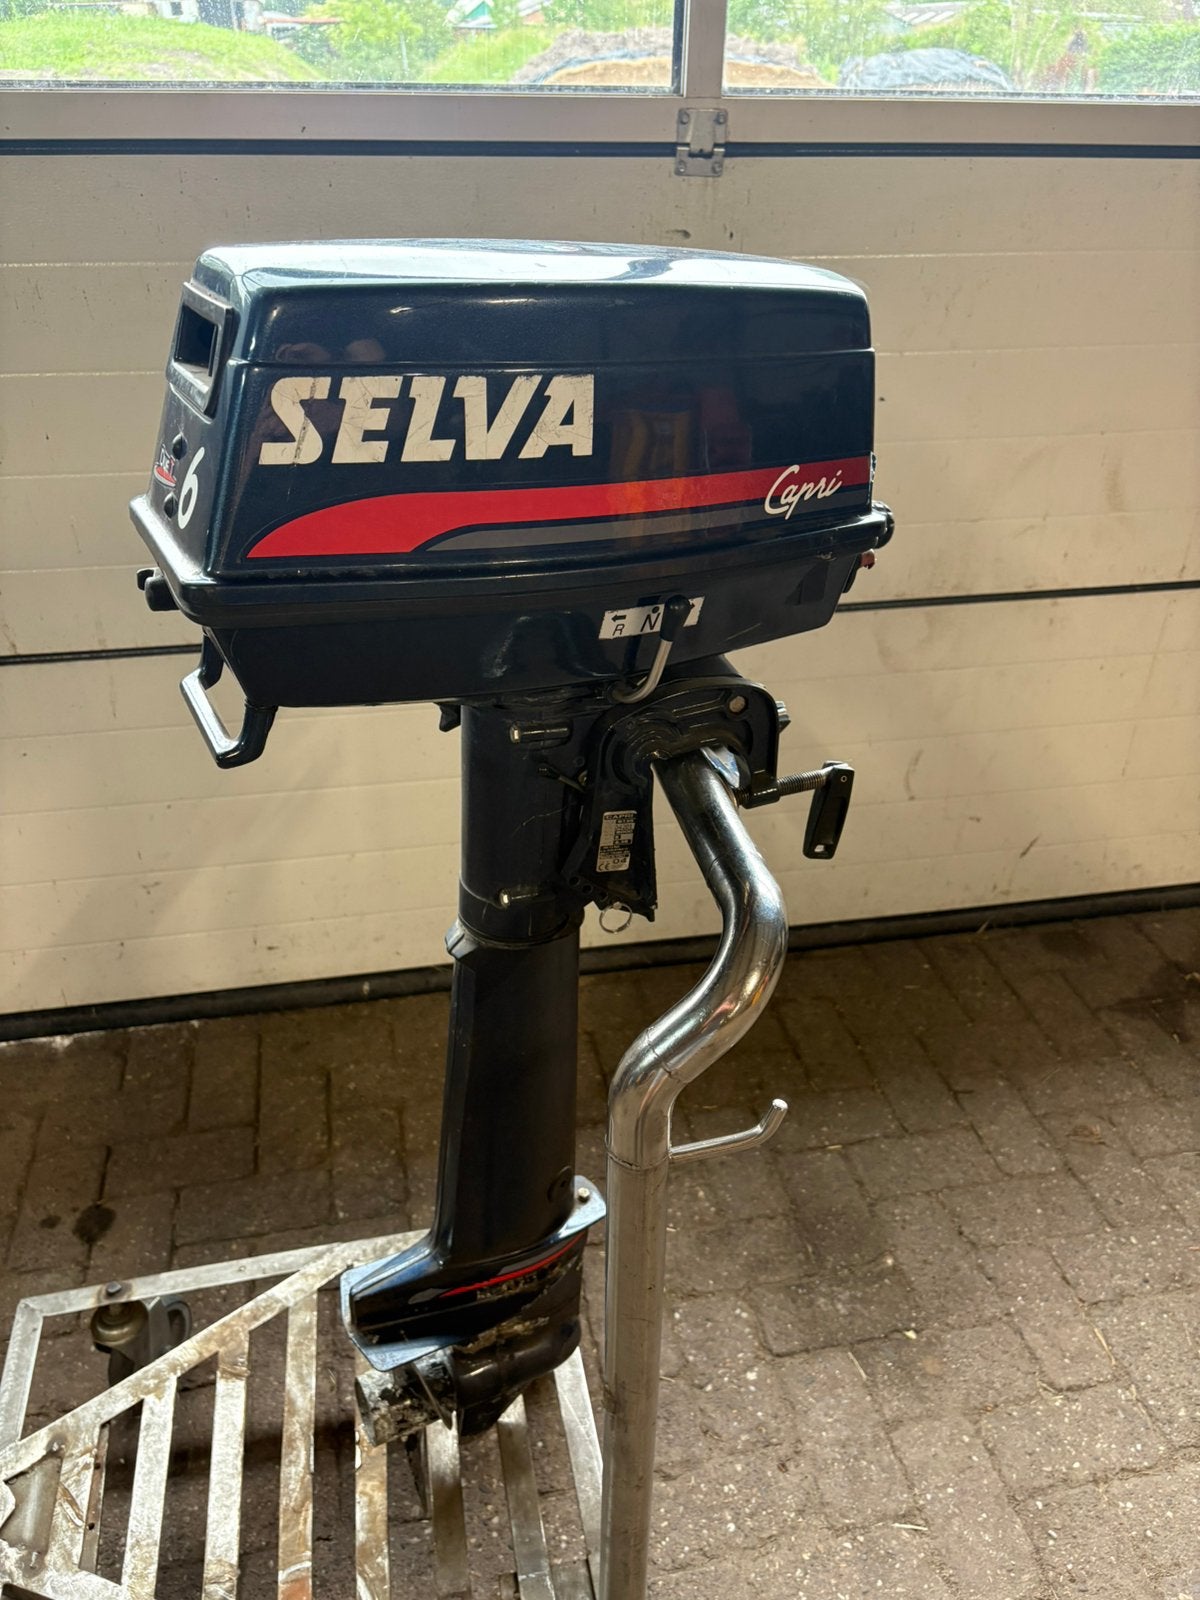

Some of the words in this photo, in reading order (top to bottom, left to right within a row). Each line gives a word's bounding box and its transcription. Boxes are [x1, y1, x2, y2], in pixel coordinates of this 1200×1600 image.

[258, 374, 595, 465] SELVA
[178, 446, 205, 529] 6
[764, 464, 843, 520] Capri
[613, 624, 625, 636] R
[640, 613, 661, 632] N
